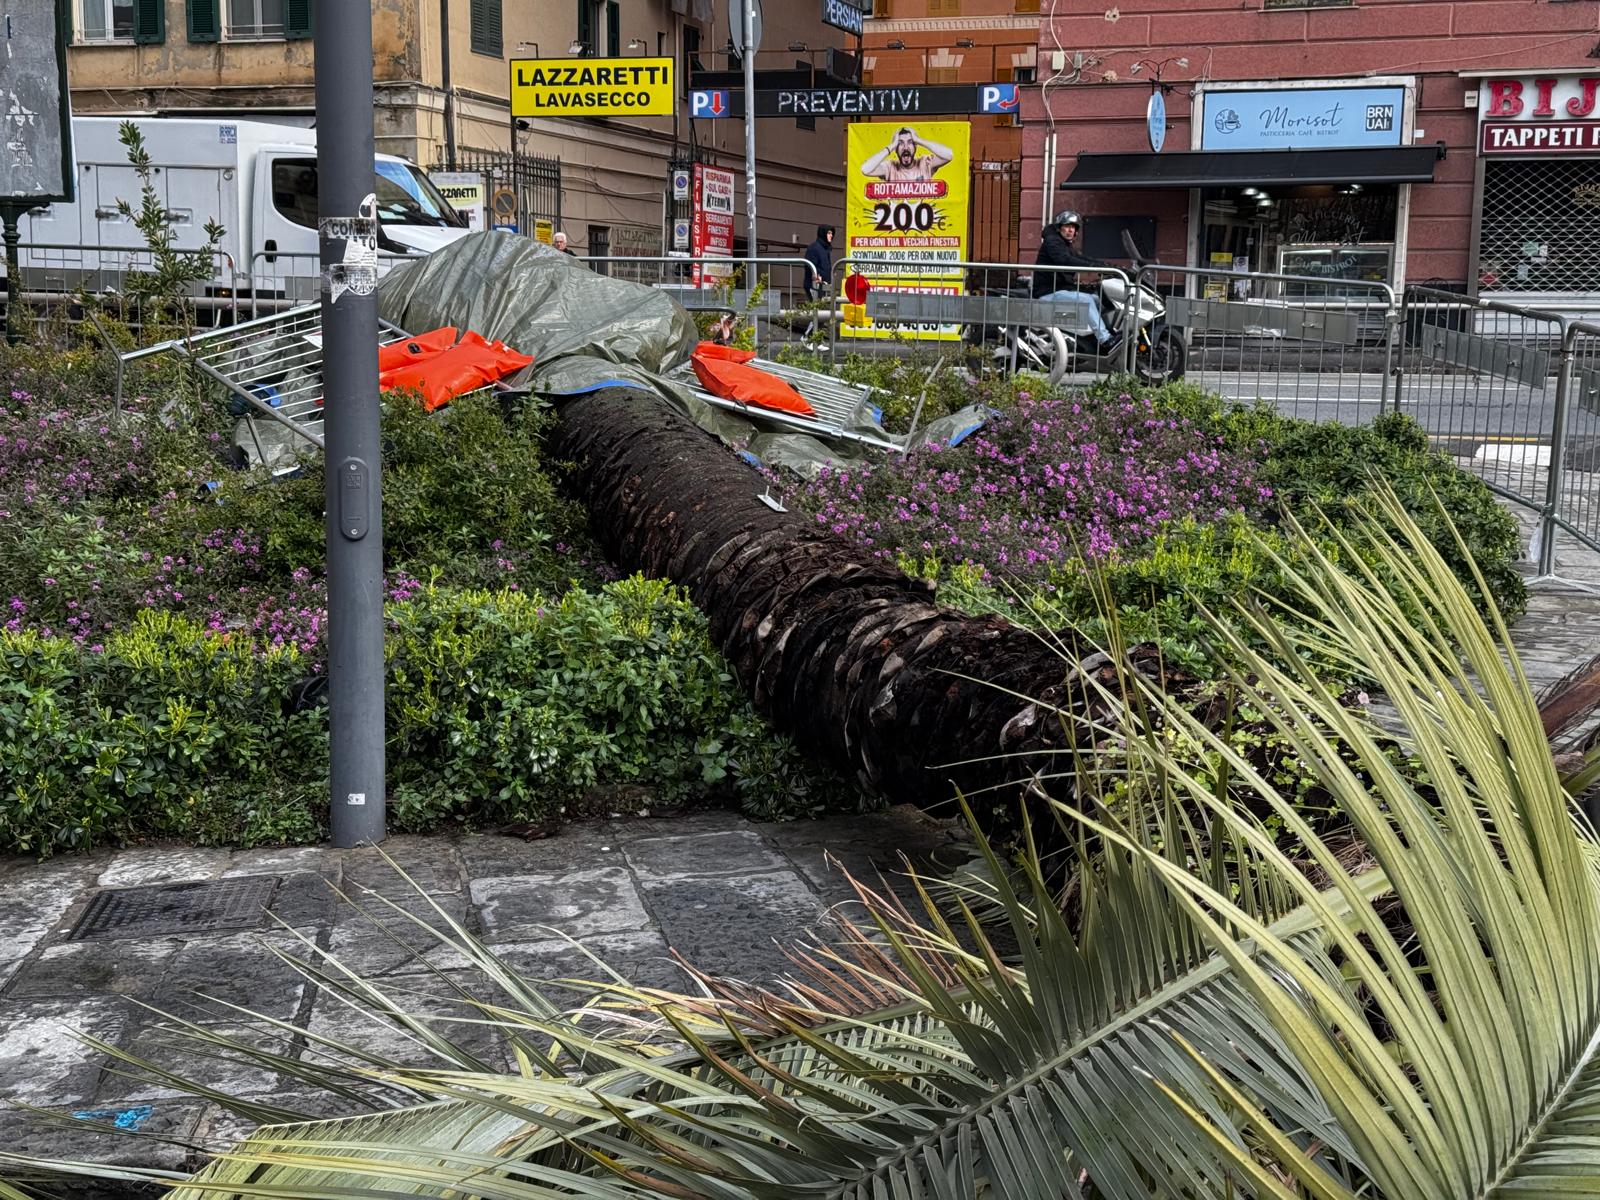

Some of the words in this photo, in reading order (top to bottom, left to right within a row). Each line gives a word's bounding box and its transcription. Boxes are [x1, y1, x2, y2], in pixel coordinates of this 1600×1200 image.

[517, 66, 668, 87] LAZZARETTI
[535, 92, 651, 108] LAVASECCO
[692, 91, 709, 116] P
[778, 90, 920, 112] PREVENTIVI
[983, 86, 1000, 111] P
[1259, 102, 1345, 129] Morisot
[1367, 106, 1393, 118] BRN
[1491, 127, 1584, 147] TAPPETI
[874, 182, 938, 195] ROTTAMAZIONE
[707, 224, 730, 236] FINESTRE
[855, 237, 868, 246] PER
[869, 237, 886, 246] OGNI
[887, 237, 900, 246] TUA
[903, 237, 928, 246] VECCHIA
[929, 237, 959, 246] FINESTRA
[852, 250, 886, 260] SCONTIAMO
[908, 251, 919, 260] PER
[920, 251, 934, 260] OGNI
[937, 251, 957, 260] NUOVO
